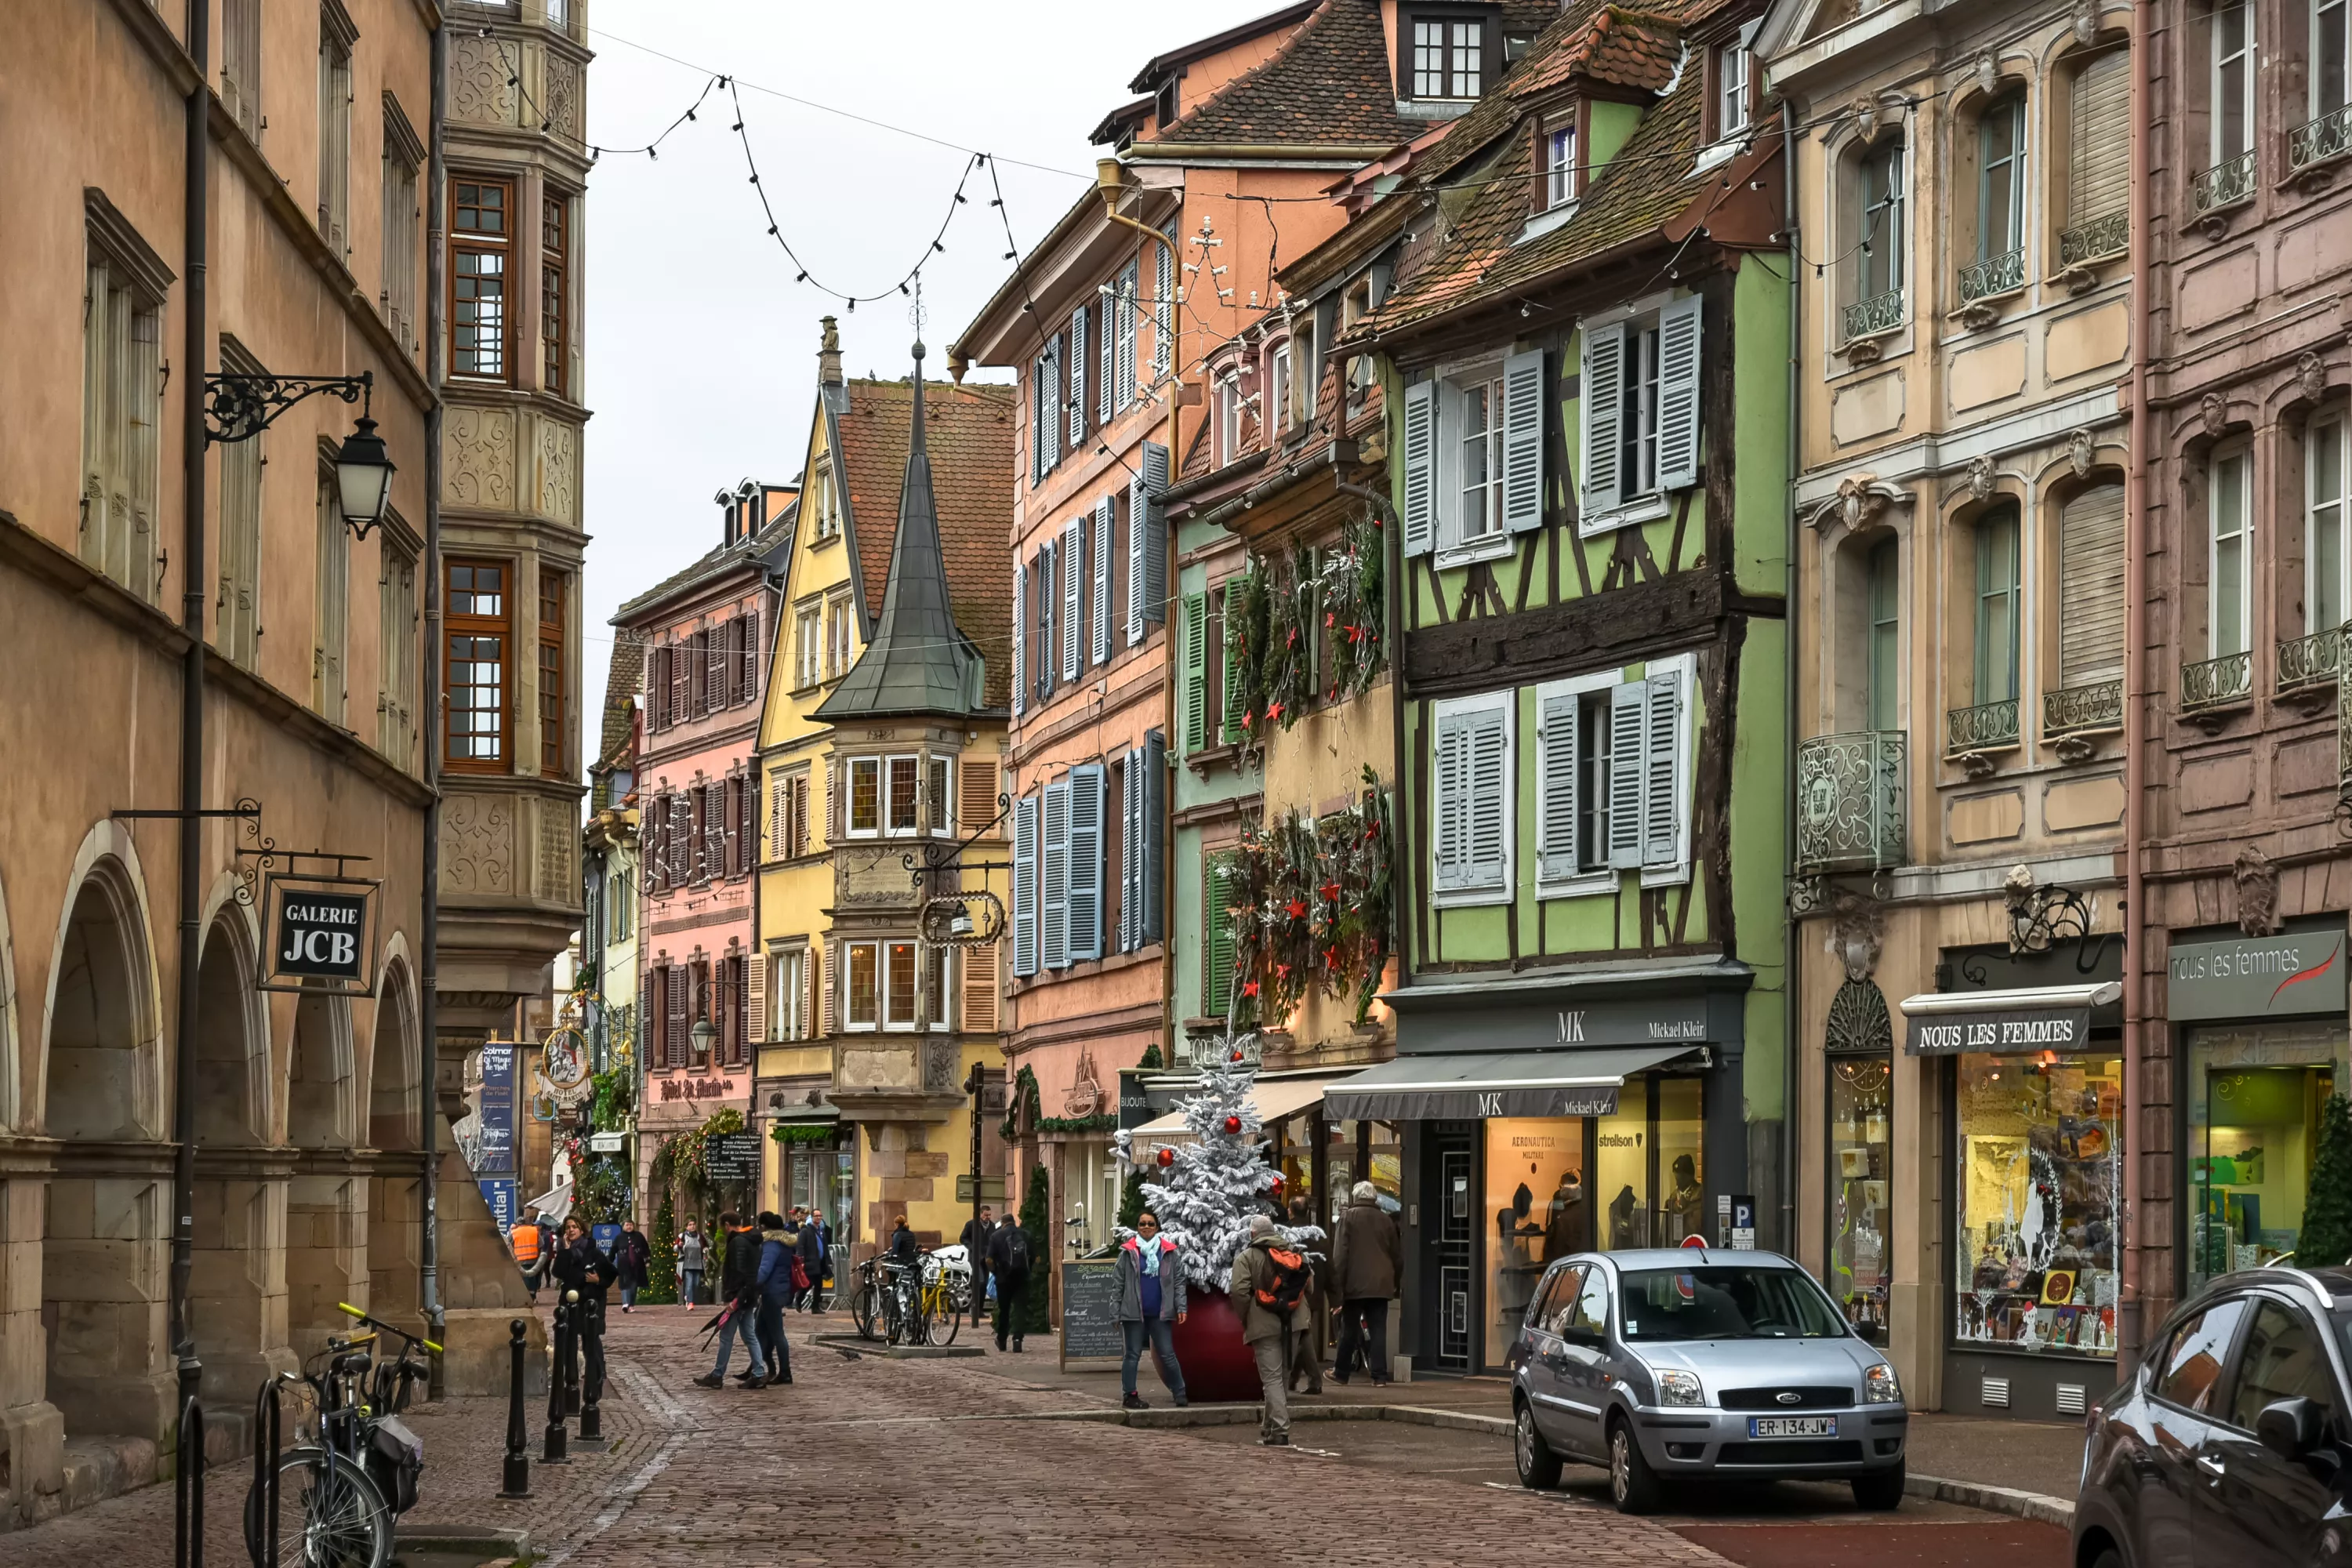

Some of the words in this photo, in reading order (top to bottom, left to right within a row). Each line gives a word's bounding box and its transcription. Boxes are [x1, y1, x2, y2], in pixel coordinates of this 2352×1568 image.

[286, 905, 358, 924] GALERIE
[284, 929, 354, 964] JCB
[2169, 956, 2205, 980] nous
[2209, 947, 2230, 978] les
[2235, 945, 2299, 975] femmes
[1556, 1011, 1585, 1043] MK
[1648, 1022, 1681, 1039] Mickael
[1682, 1020, 1704, 1037] Kleir
[1919, 1025, 1962, 1048] NOUS
[1967, 1023, 1997, 1046] LES
[2002, 1019, 2073, 1044] FEMMES
[554, 1087, 576, 1096] HOTEL
[1478, 1093, 1503, 1116] MK
[1564, 1101, 1592, 1115] Mickael
[1512, 1136, 1555, 1148] AERONAUTICA
[1599, 1134, 1633, 1148] strellson
[1523, 1151, 1544, 1160] MILITARE
[1737, 1206, 1749, 1227] P
[1758, 1419, 1828, 1435] ER-134-JW
